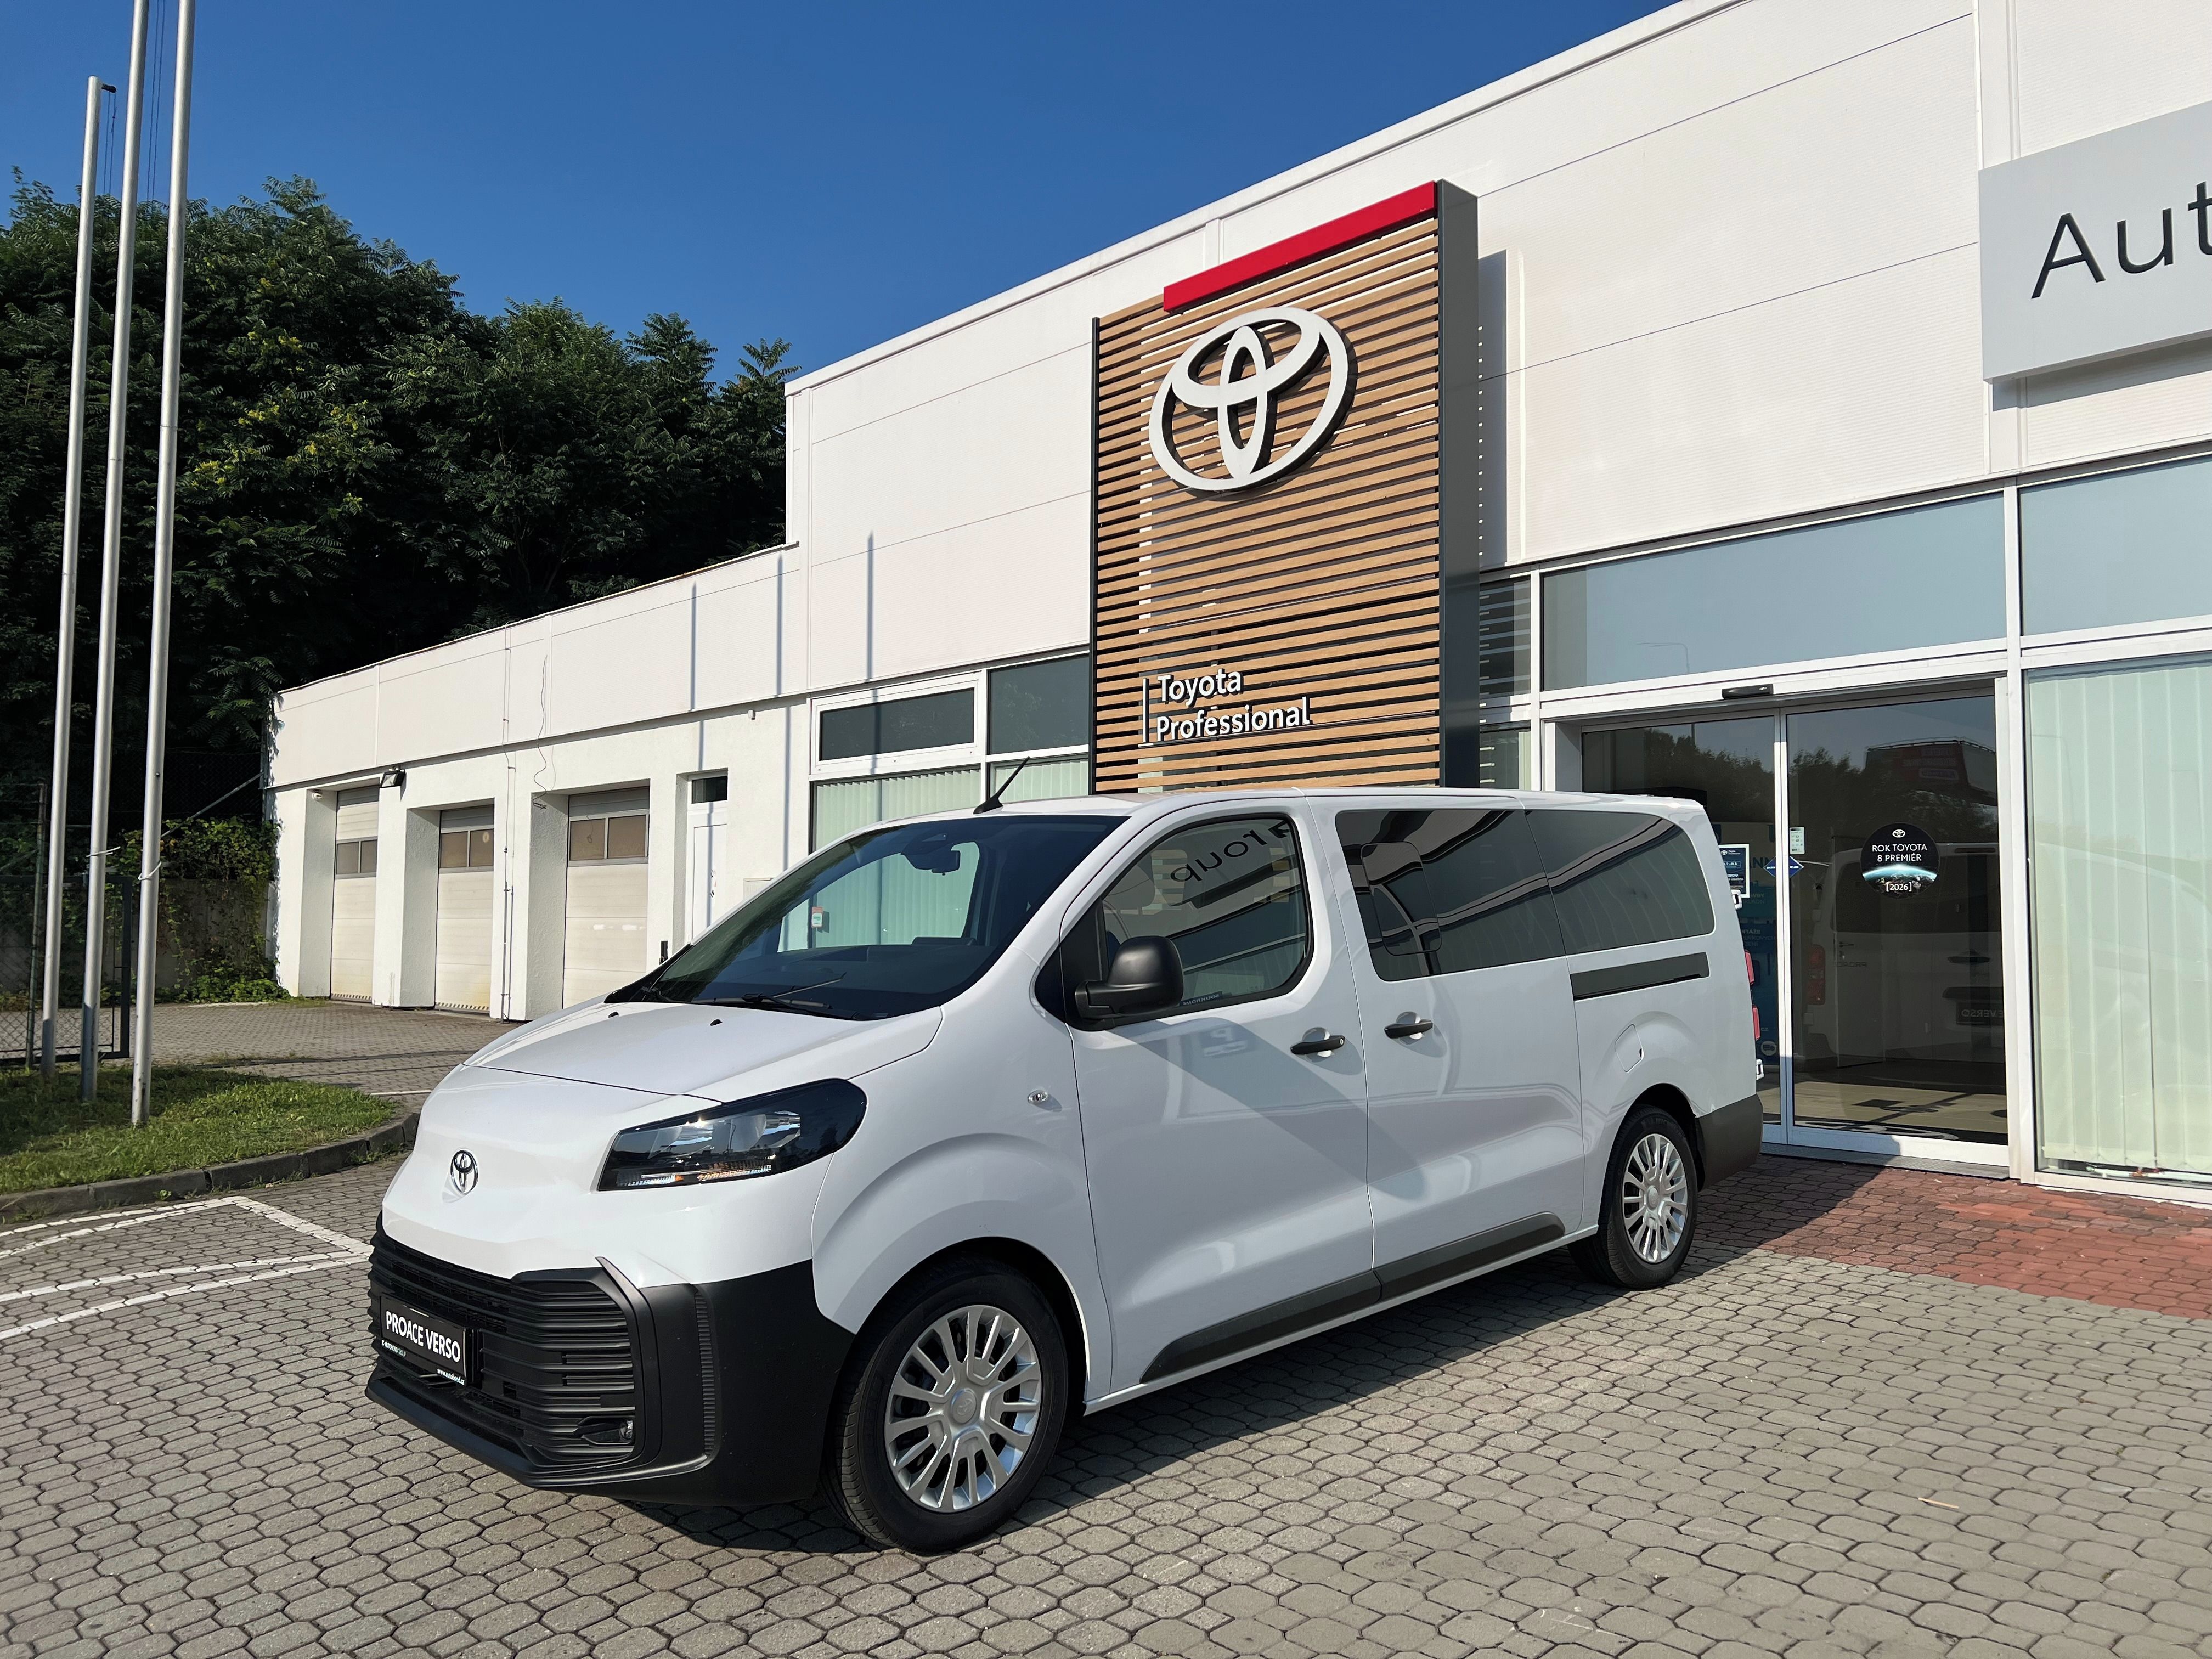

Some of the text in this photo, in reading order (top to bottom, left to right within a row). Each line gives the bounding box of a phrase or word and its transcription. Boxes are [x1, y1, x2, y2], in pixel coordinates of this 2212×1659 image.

[1156, 668, 1242, 707] Toyota
[1156, 696, 1311, 741] Professional
[1892, 843, 1928, 851] TOYOTA
[386, 1311, 461, 1363] PROACE VERSO
